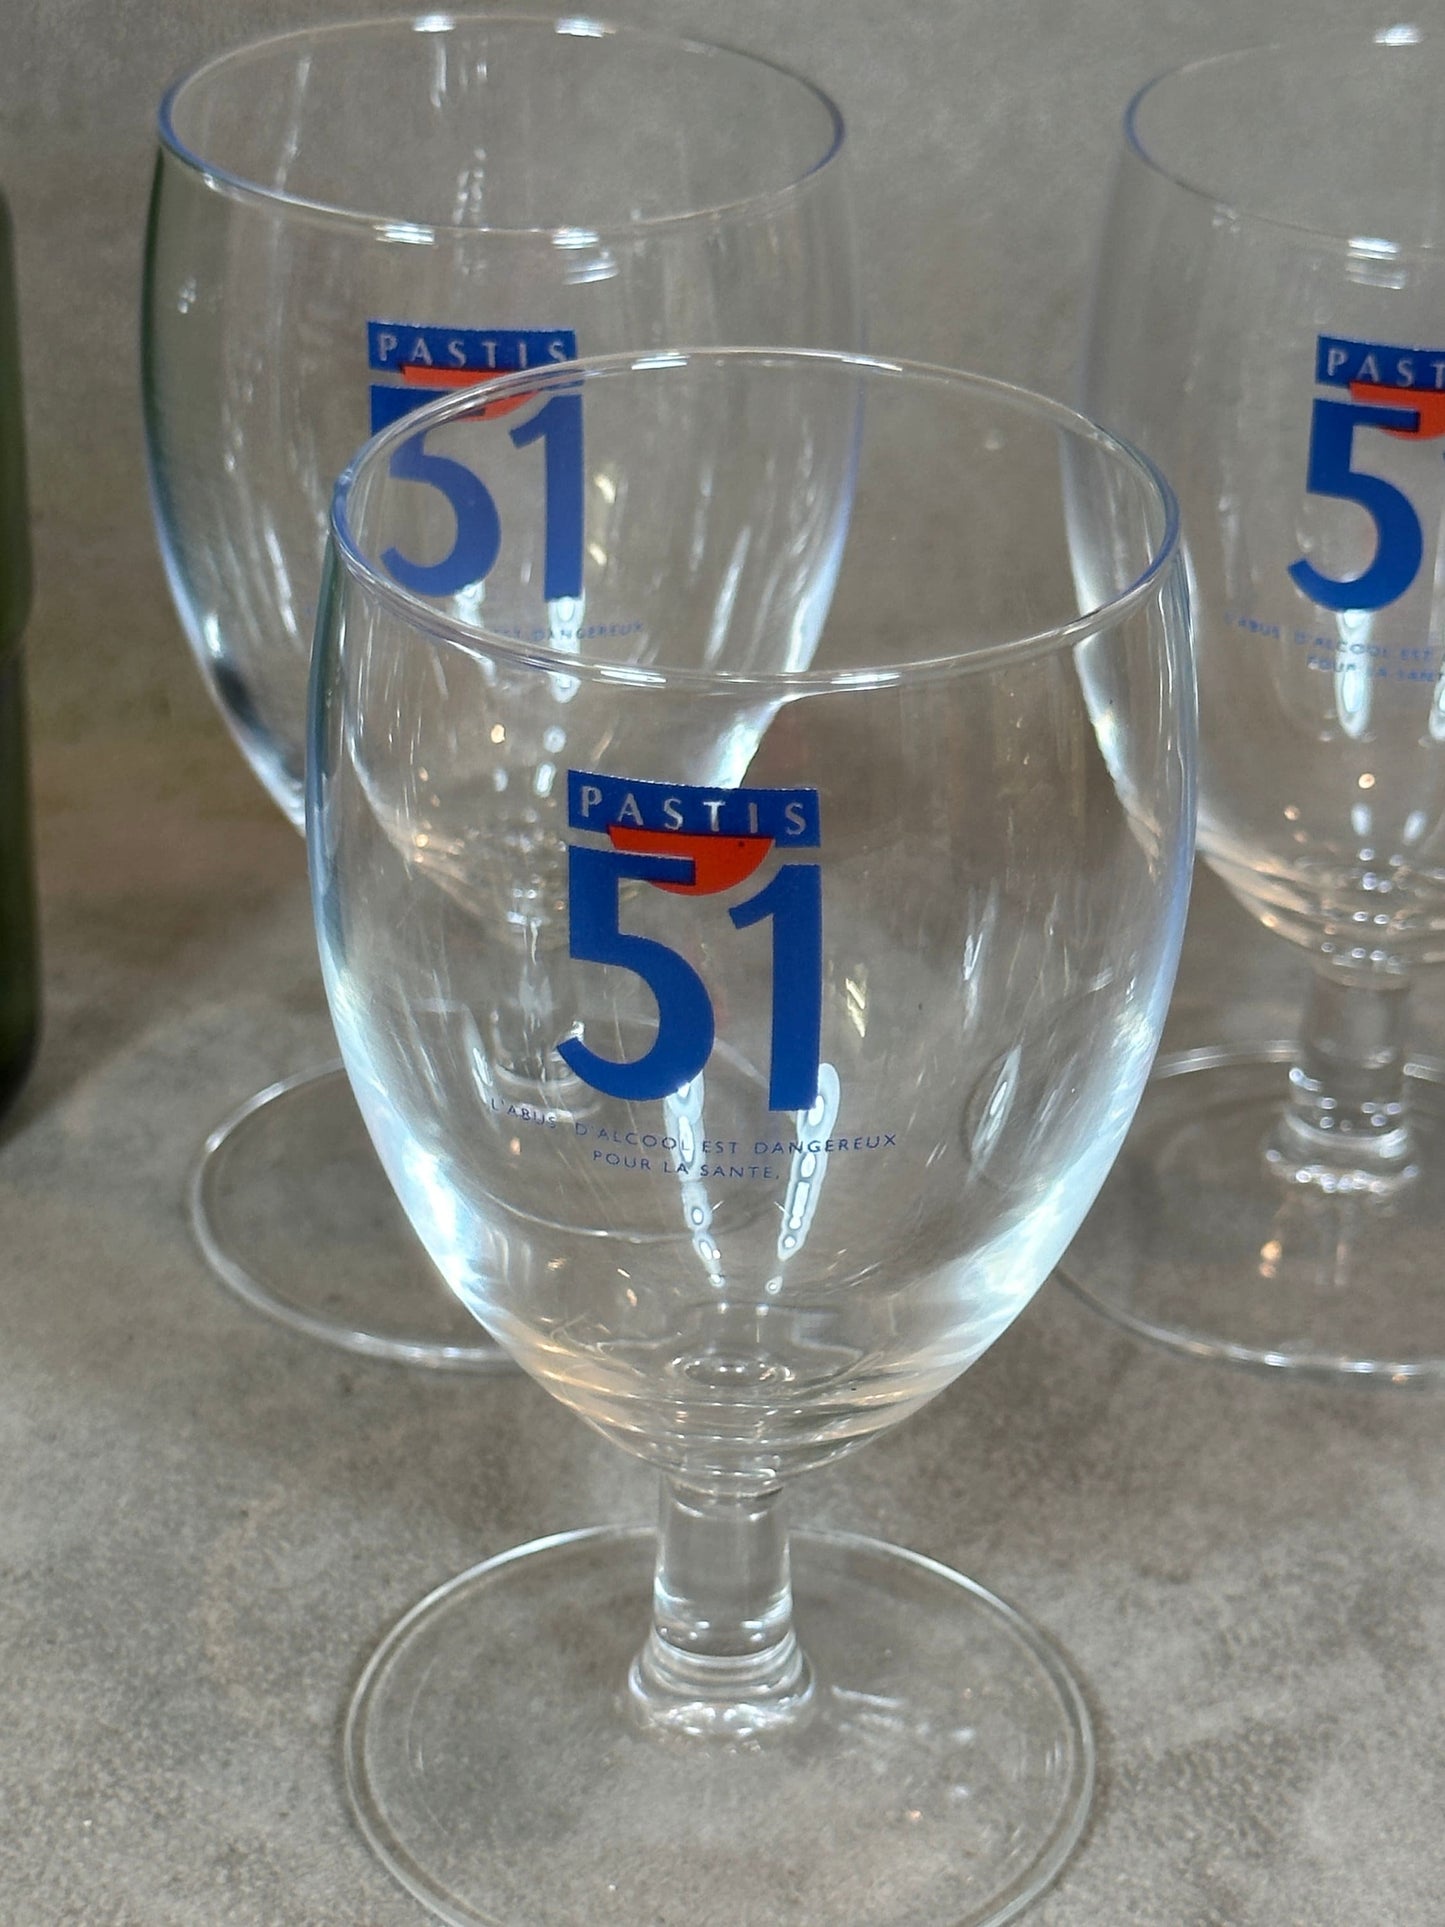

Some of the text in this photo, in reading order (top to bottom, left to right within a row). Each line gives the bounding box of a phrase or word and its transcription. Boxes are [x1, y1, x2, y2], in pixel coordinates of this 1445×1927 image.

[378, 332, 566, 369] PASTIS
[368, 384, 584, 601] 51
[1287, 398, 1445, 613] 5
[580, 784, 808, 836] PASTIS
[556, 844, 823, 1112] 51
[490, 1097, 897, 1155] L'ABUS D'ALCOOL EST DANGEREUX
[592, 1149, 651, 1170] POUR
[663, 1161, 690, 1175] LA
